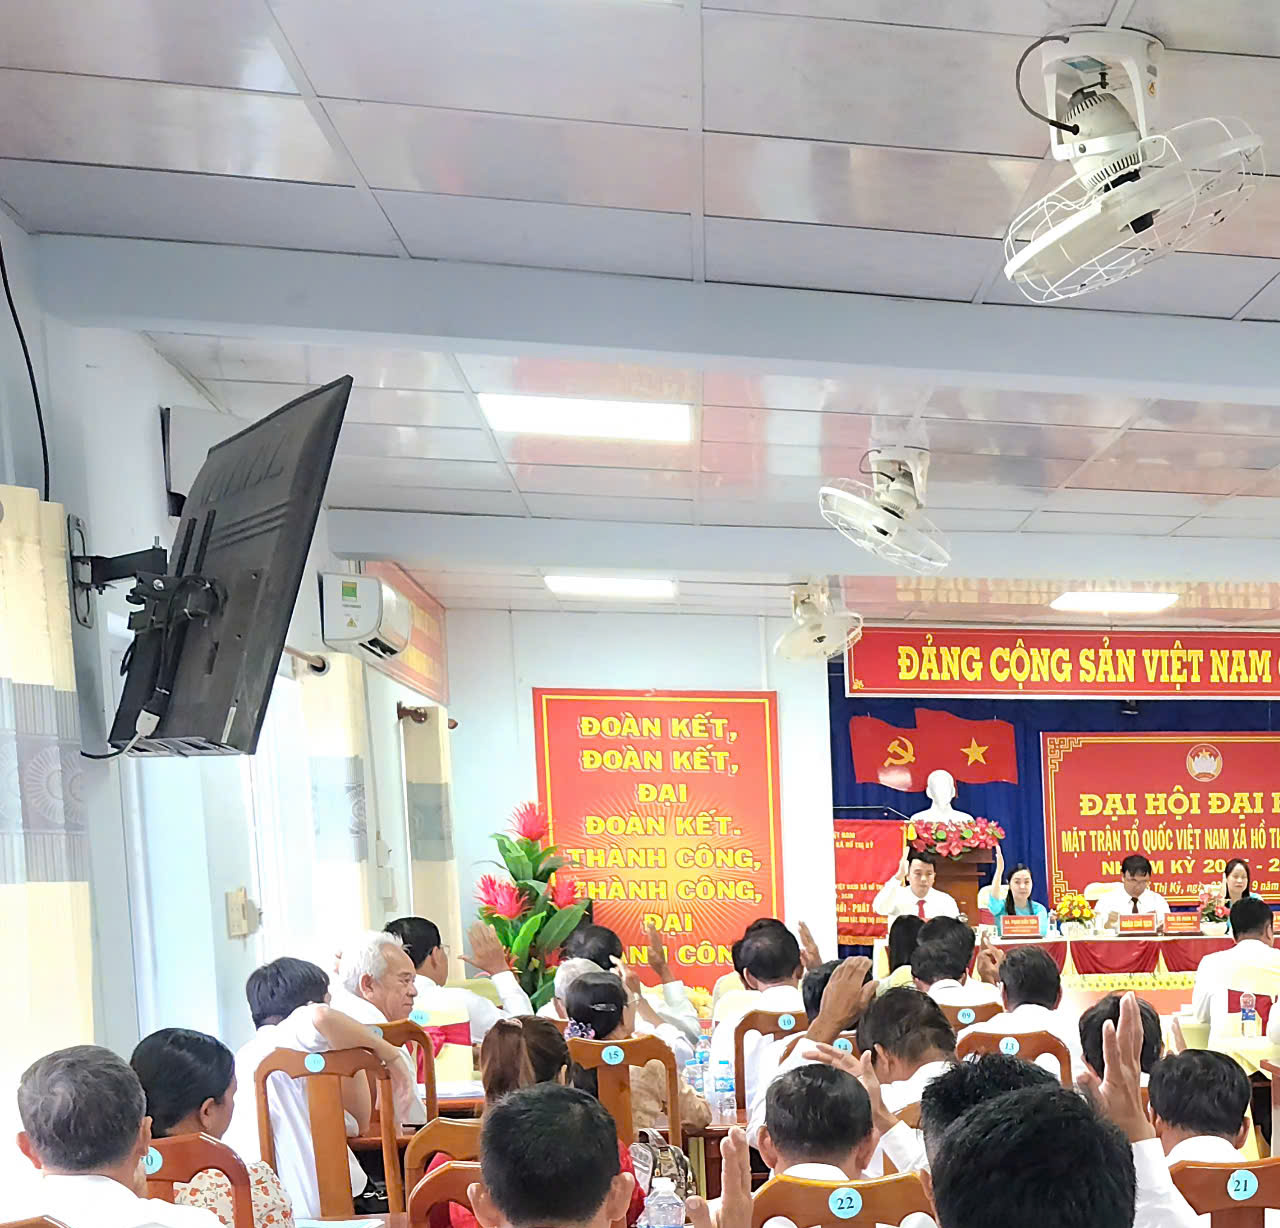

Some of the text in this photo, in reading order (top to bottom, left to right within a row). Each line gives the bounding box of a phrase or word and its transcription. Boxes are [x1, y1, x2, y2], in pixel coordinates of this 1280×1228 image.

[898, 633, 983, 681] ĐẢNG
[989, 638, 1072, 689] CỘNG
[1079, 636, 1136, 683] SẢN
[1142, 640, 1203, 691] VIỆT
[1210, 650, 1272, 683] NAM
[579, 711, 738, 743] ĐOÀN KẾT,
[581, 744, 739, 775] ĐOÀN KẾT,
[637, 783, 687, 806] ĐẠI
[1080, 792, 1138, 821] ĐẠI
[1145, 785, 1201, 820] HỘI
[1208, 792, 1264, 819] ĐẠI
[585, 809, 741, 838] ĐOÀN KẾT.
[1061, 827, 1086, 857] MẶT
[1089, 825, 1121, 855] TRẬN
[1123, 818, 1139, 851] TỔ
[1142, 821, 1173, 855] QUỐC
[1176, 823, 1201, 852] VIỆT
[1204, 828, 1230, 850] NAM
[1232, 822, 1248, 849] XÃ
[1250, 818, 1266, 849] HỒ
[566, 843, 761, 871] THÀNH CÔNG,
[1102, 860, 1164, 875] NHM
[1171, 855, 1196, 874] KỲ
[677, 875, 763, 903] CÔNG,
[1261, 881, 1279, 890] năm
[643, 911, 693, 936] ĐẠI
[678, 941, 733, 965] CÔN
[608, 1051, 619, 1061] 15
[1234, 1179, 1249, 1193] 21
[836, 1196, 855, 1210] 22
